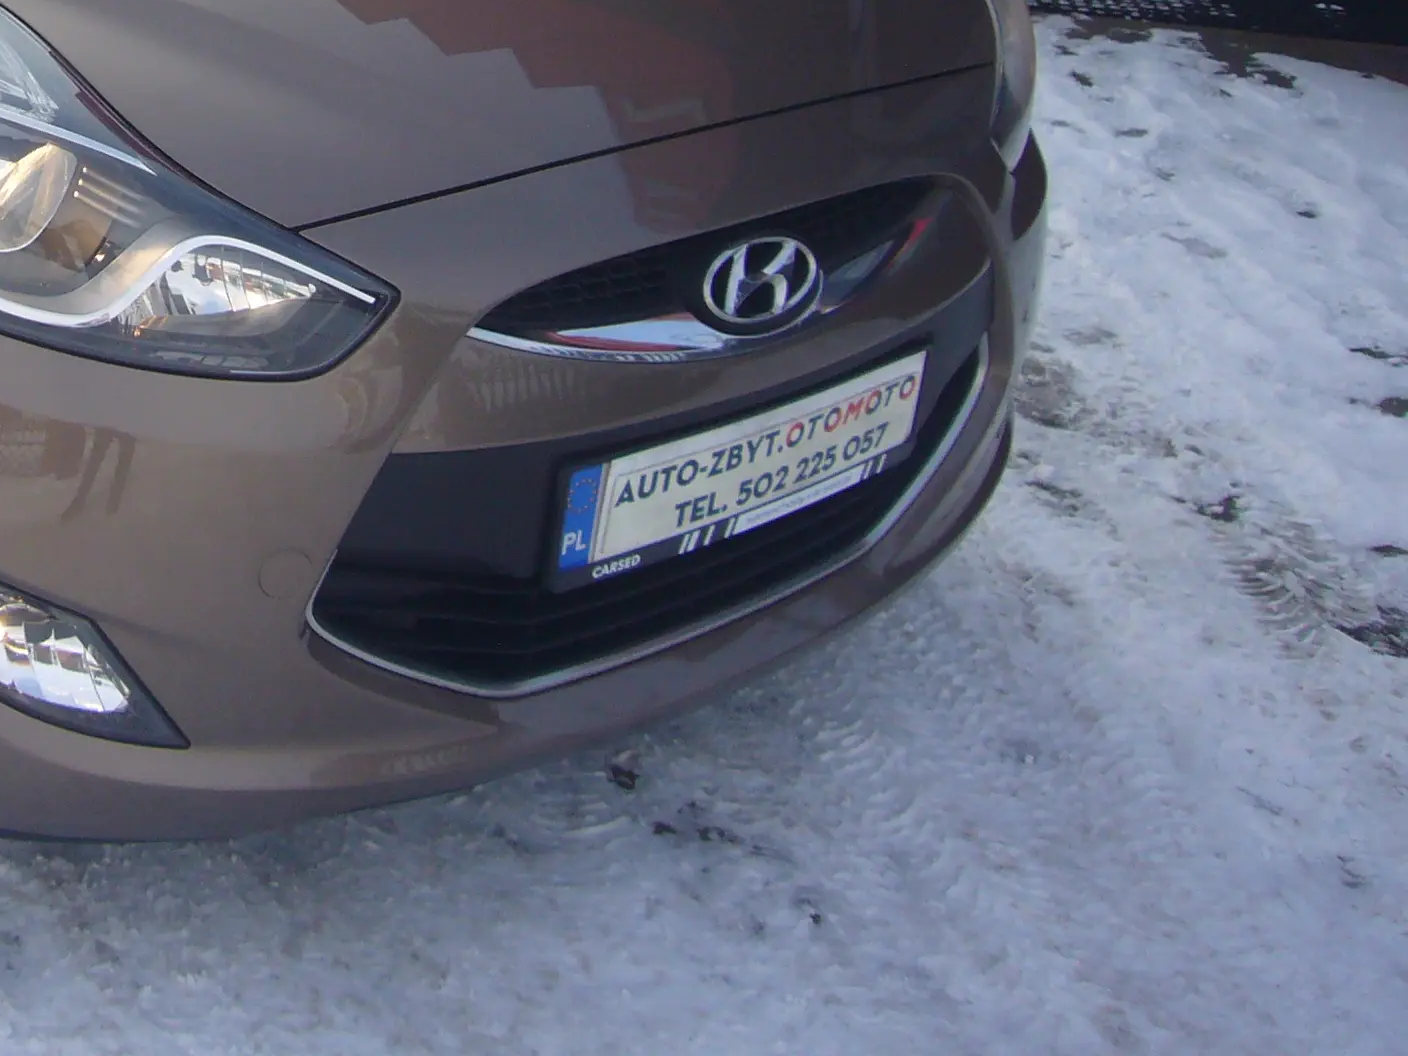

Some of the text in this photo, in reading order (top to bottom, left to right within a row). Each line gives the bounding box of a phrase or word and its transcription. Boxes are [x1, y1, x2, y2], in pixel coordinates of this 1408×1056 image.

[614, 374, 917, 509] AUTO-ZBYT.OTOMOTO
[674, 491, 729, 529] TEL.
[735, 465, 790, 507] 502
[792, 444, 838, 485] 225
[842, 421, 890, 462] 057
[560, 529, 587, 556] PL
[592, 554, 642, 580] CARSED
